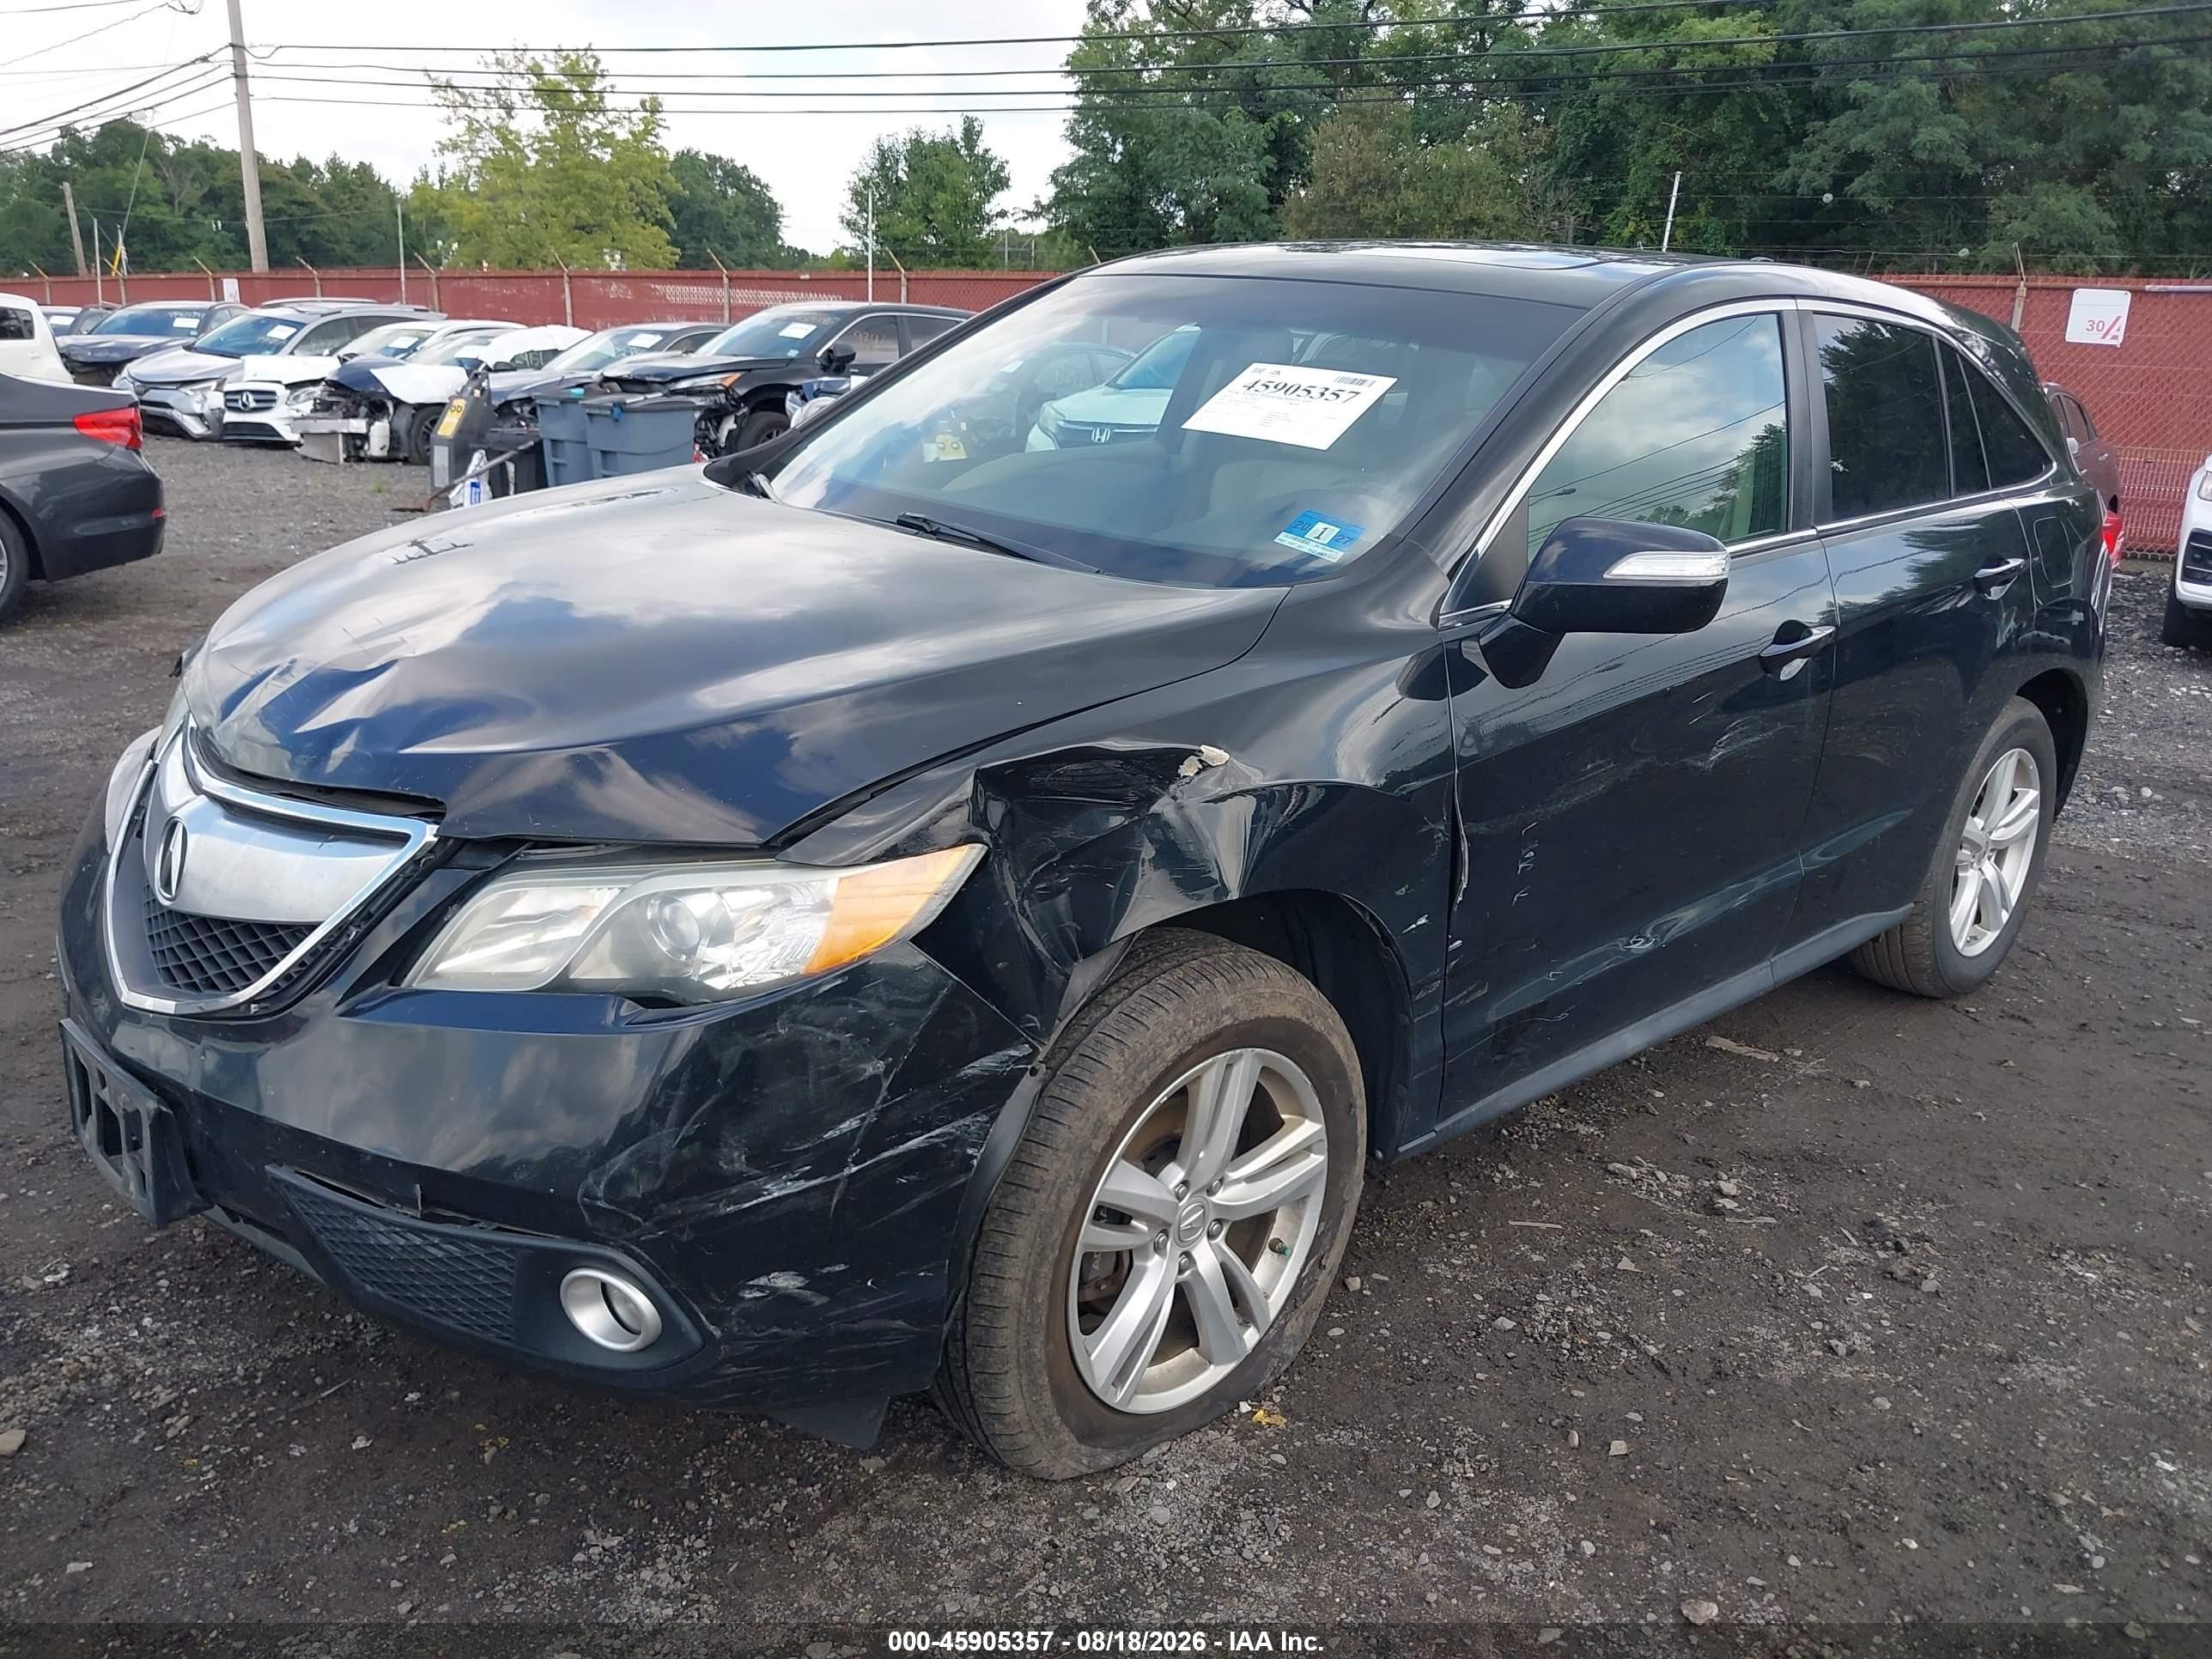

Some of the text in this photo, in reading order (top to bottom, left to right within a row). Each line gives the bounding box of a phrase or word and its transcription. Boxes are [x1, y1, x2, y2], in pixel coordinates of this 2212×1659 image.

[1242, 378, 1361, 404] 45905357
[1293, 520, 1310, 531] 20
[1313, 527, 1329, 540] 1
[1334, 534, 1354, 545] 27
